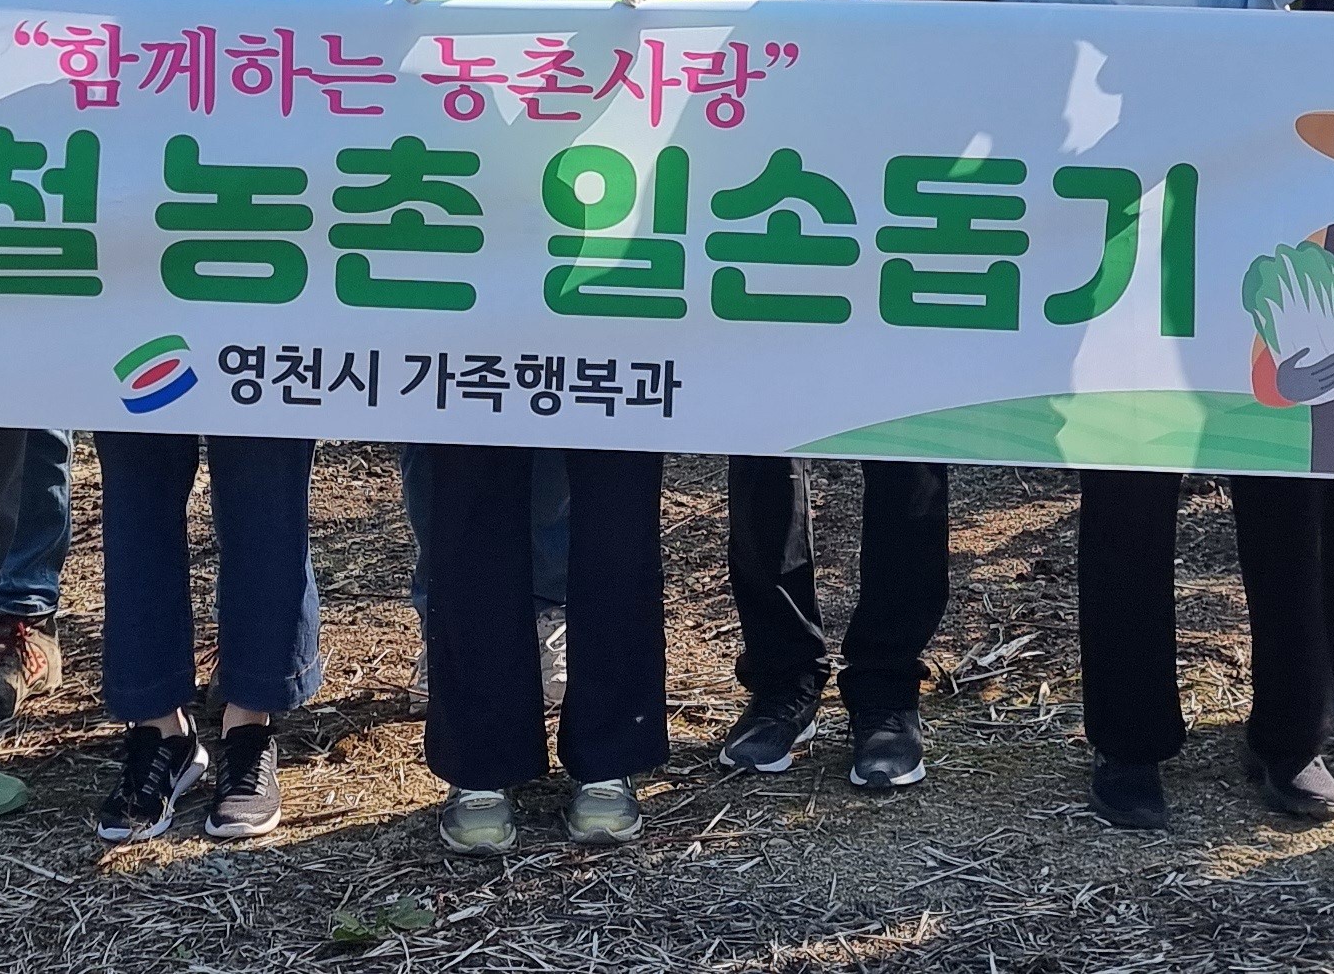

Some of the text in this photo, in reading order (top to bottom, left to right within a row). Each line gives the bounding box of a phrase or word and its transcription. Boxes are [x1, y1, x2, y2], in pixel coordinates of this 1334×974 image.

[14, 22, 799, 129] “함께하는 농촌사랑”
[154, 134, 484, 311] 농촌
[542, 144, 1199, 337] 일손돕기
[217, 344, 683, 418] 영천시 가족행복과
